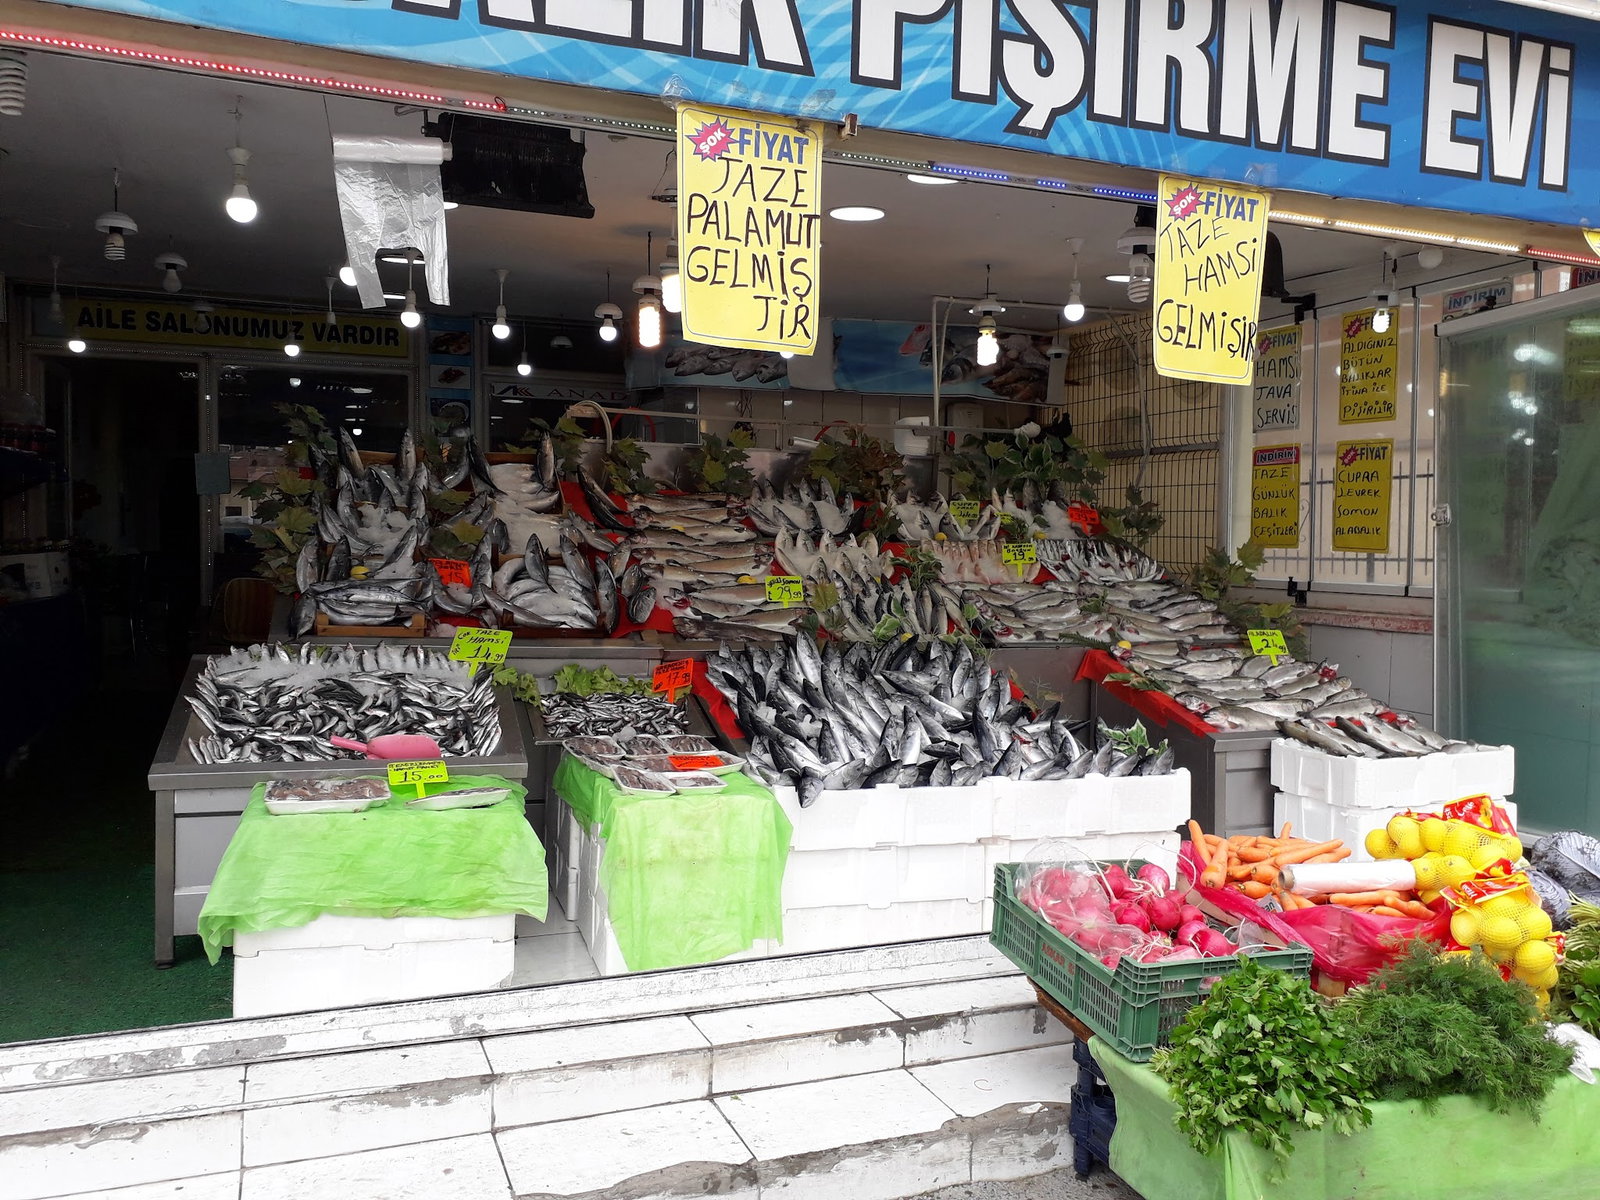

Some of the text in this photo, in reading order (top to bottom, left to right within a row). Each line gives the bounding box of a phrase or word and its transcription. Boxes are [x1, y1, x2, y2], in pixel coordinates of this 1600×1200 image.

[699, 123, 809, 164] ŞOK FİYAT
[687, 193, 820, 249] PALAMUT
[1172, 187, 1259, 222] ŞOK FİYAT
[1160, 216, 1229, 262] TAZE
[687, 245, 812, 302] GELMİŞ
[78, 303, 399, 346] AİLE SALONUMUZ VARDIR
[1256, 448, 1297, 463] İNDİRİM
[1360, 444, 1388, 460] FİYAT
[1253, 467, 1292, 480] TAZE
[1253, 507, 1288, 519] BALIK
